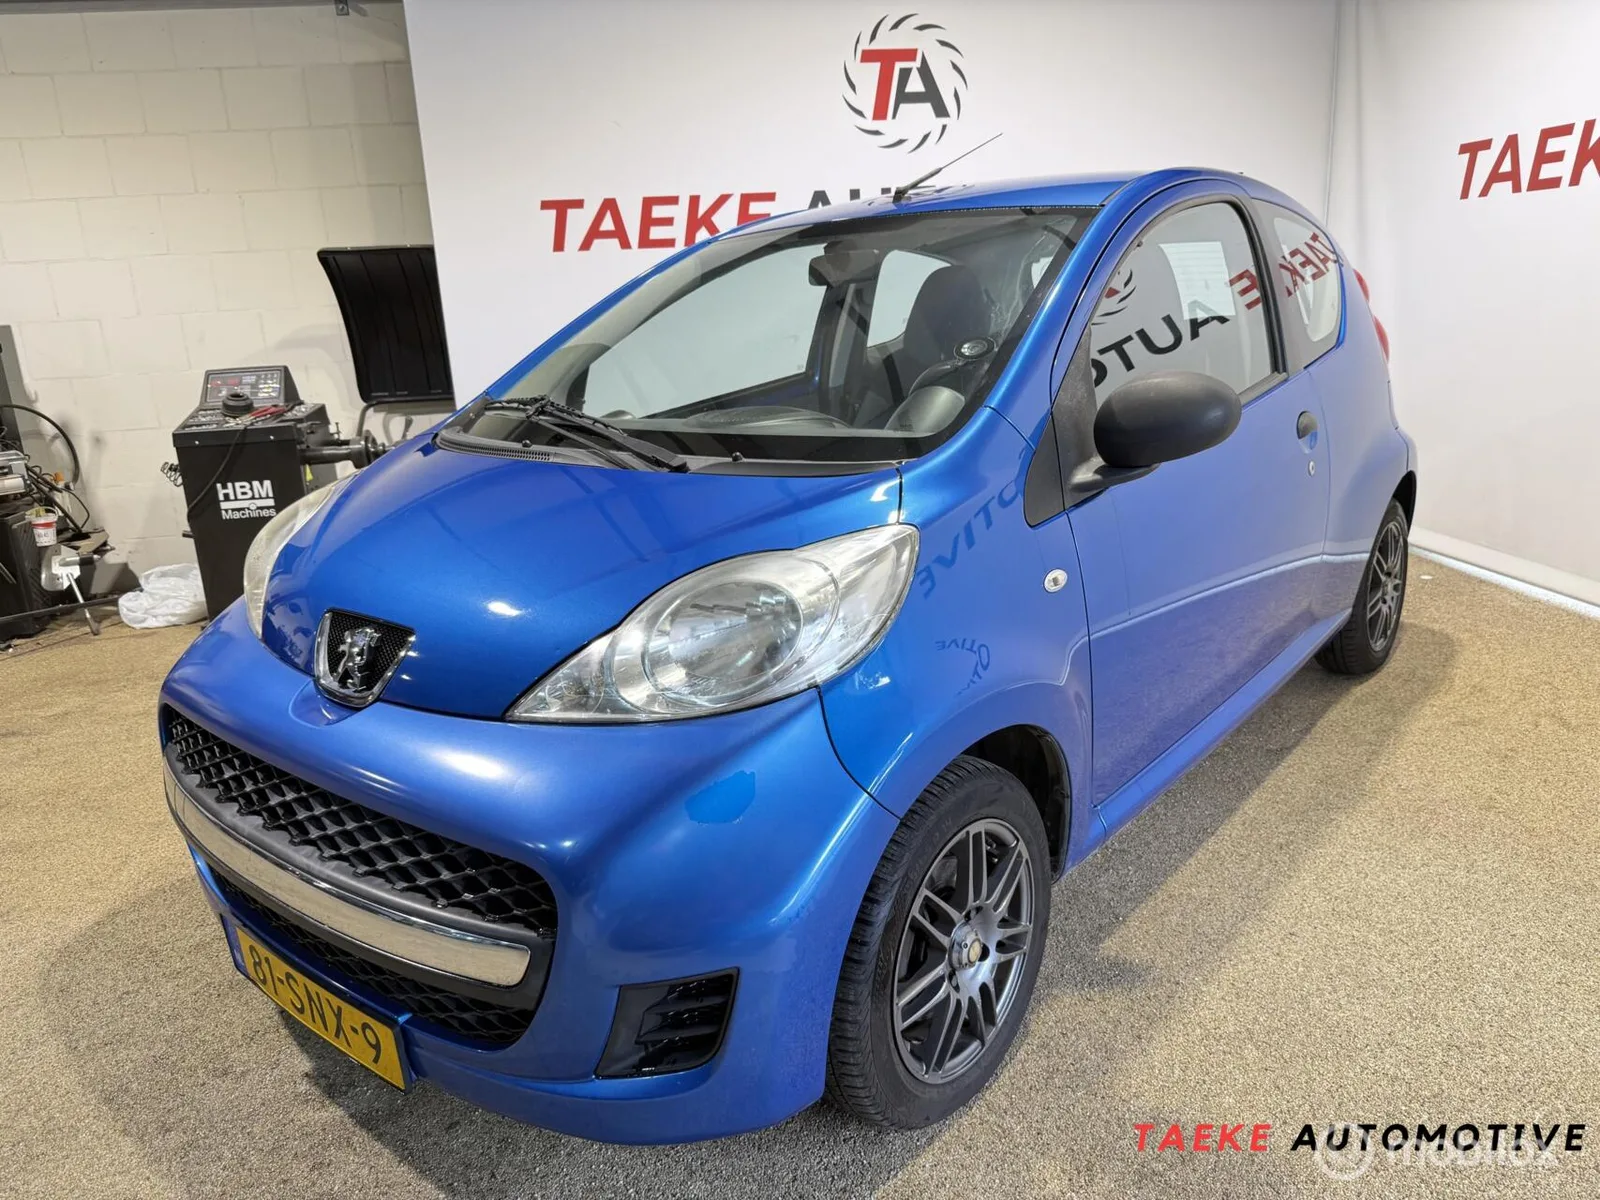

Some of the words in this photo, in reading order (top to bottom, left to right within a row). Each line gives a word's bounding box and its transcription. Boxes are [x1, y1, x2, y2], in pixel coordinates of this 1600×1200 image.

[860, 47, 950, 122] TA
[540, 191, 777, 253] TAEKE
[216, 479, 274, 501] HBM
[221, 508, 277, 520] Machines
[249, 944, 382, 1064] 81-SNX-9
